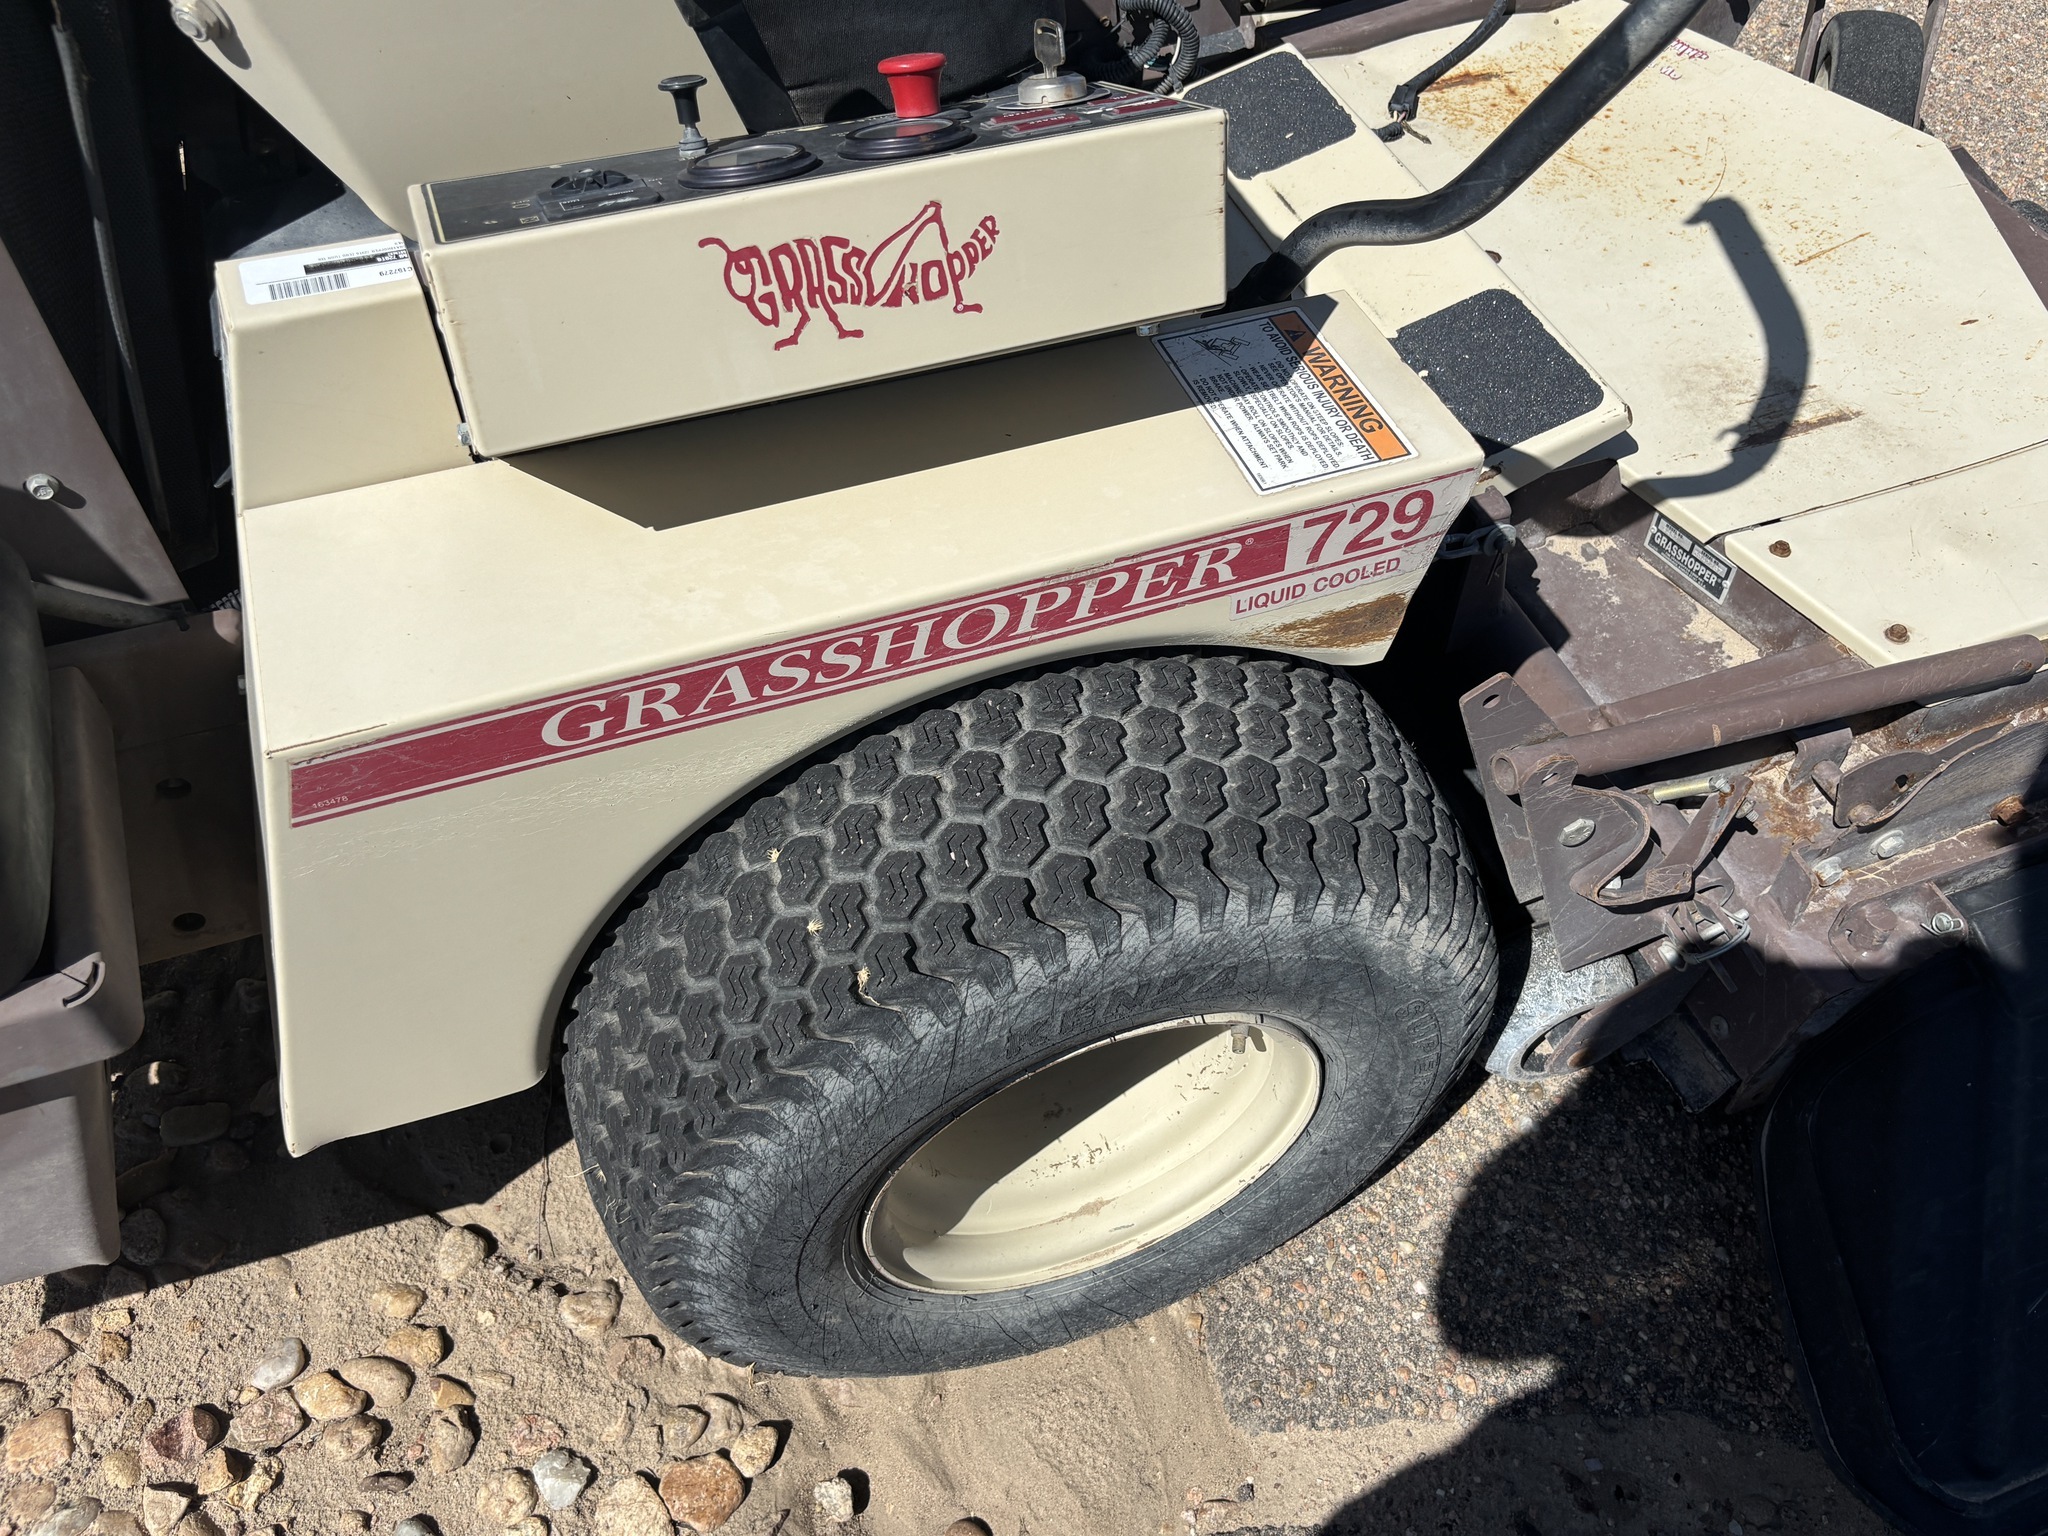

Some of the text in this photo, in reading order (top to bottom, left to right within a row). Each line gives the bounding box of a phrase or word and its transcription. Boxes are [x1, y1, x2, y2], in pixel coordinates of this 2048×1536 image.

[1199, 377, 1209, 386] DO
[1204, 385, 1217, 396] NOT
[1212, 396, 1233, 419] OPERATE
[1229, 419, 1244, 435] WHEN
[1241, 435, 1268, 468] ATTACHMENT
[1215, 373, 1228, 384] NOT
[1223, 384, 1239, 402] UNDER
[1252, 423, 1270, 443] ALWAYS
[1266, 443, 1278, 453] SET
[1274, 454, 1288, 469] PARK
[1223, 372, 1293, 463] MACHINE MAY ROLL ON SLOPES WHEN
[1240, 368, 1308, 456] OPERATE CONTROLS SMOOTHLY AND
[1246, 390, 1272, 419] ESPECIALLY
[1269, 420, 1279, 428] ON
[1249, 366, 1264, 381] WEAR
[1260, 380, 1282, 404] SEATBELT
[1278, 405, 1293, 420] WHEN
[1290, 420, 1304, 435] ROPS
[1258, 321, 1374, 460] TO AVOID SERIOUS INJURY OR DEATH
[1258, 364, 1274, 381] NEVER
[1270, 380, 1291, 403] OPERATE
[1288, 403, 1308, 425] WITHOUT
[1305, 425, 1319, 440] ROPS
[1267, 362, 1279, 373] SEE
[1275, 372, 1301, 402] OPERATOR'S
[1298, 402, 1316, 423] MANUAL
[1314, 423, 1326, 434] FOR
[1274, 360, 1284, 368] DO
[1280, 368, 1292, 379] NOT
[1287, 378, 1309, 401] OPERATE
[1306, 401, 1315, 409] ON
[1312, 409, 1328, 425] STEEP
[1302, 347, 1382, 432] WARNING
[1303, 489, 1434, 565] 729
[1654, 533, 1718, 587] GRASSHOPPER
[1235, 556, 1401, 615] LIQUID COOLED
[541, 540, 1240, 748] GRASSHOPPER
